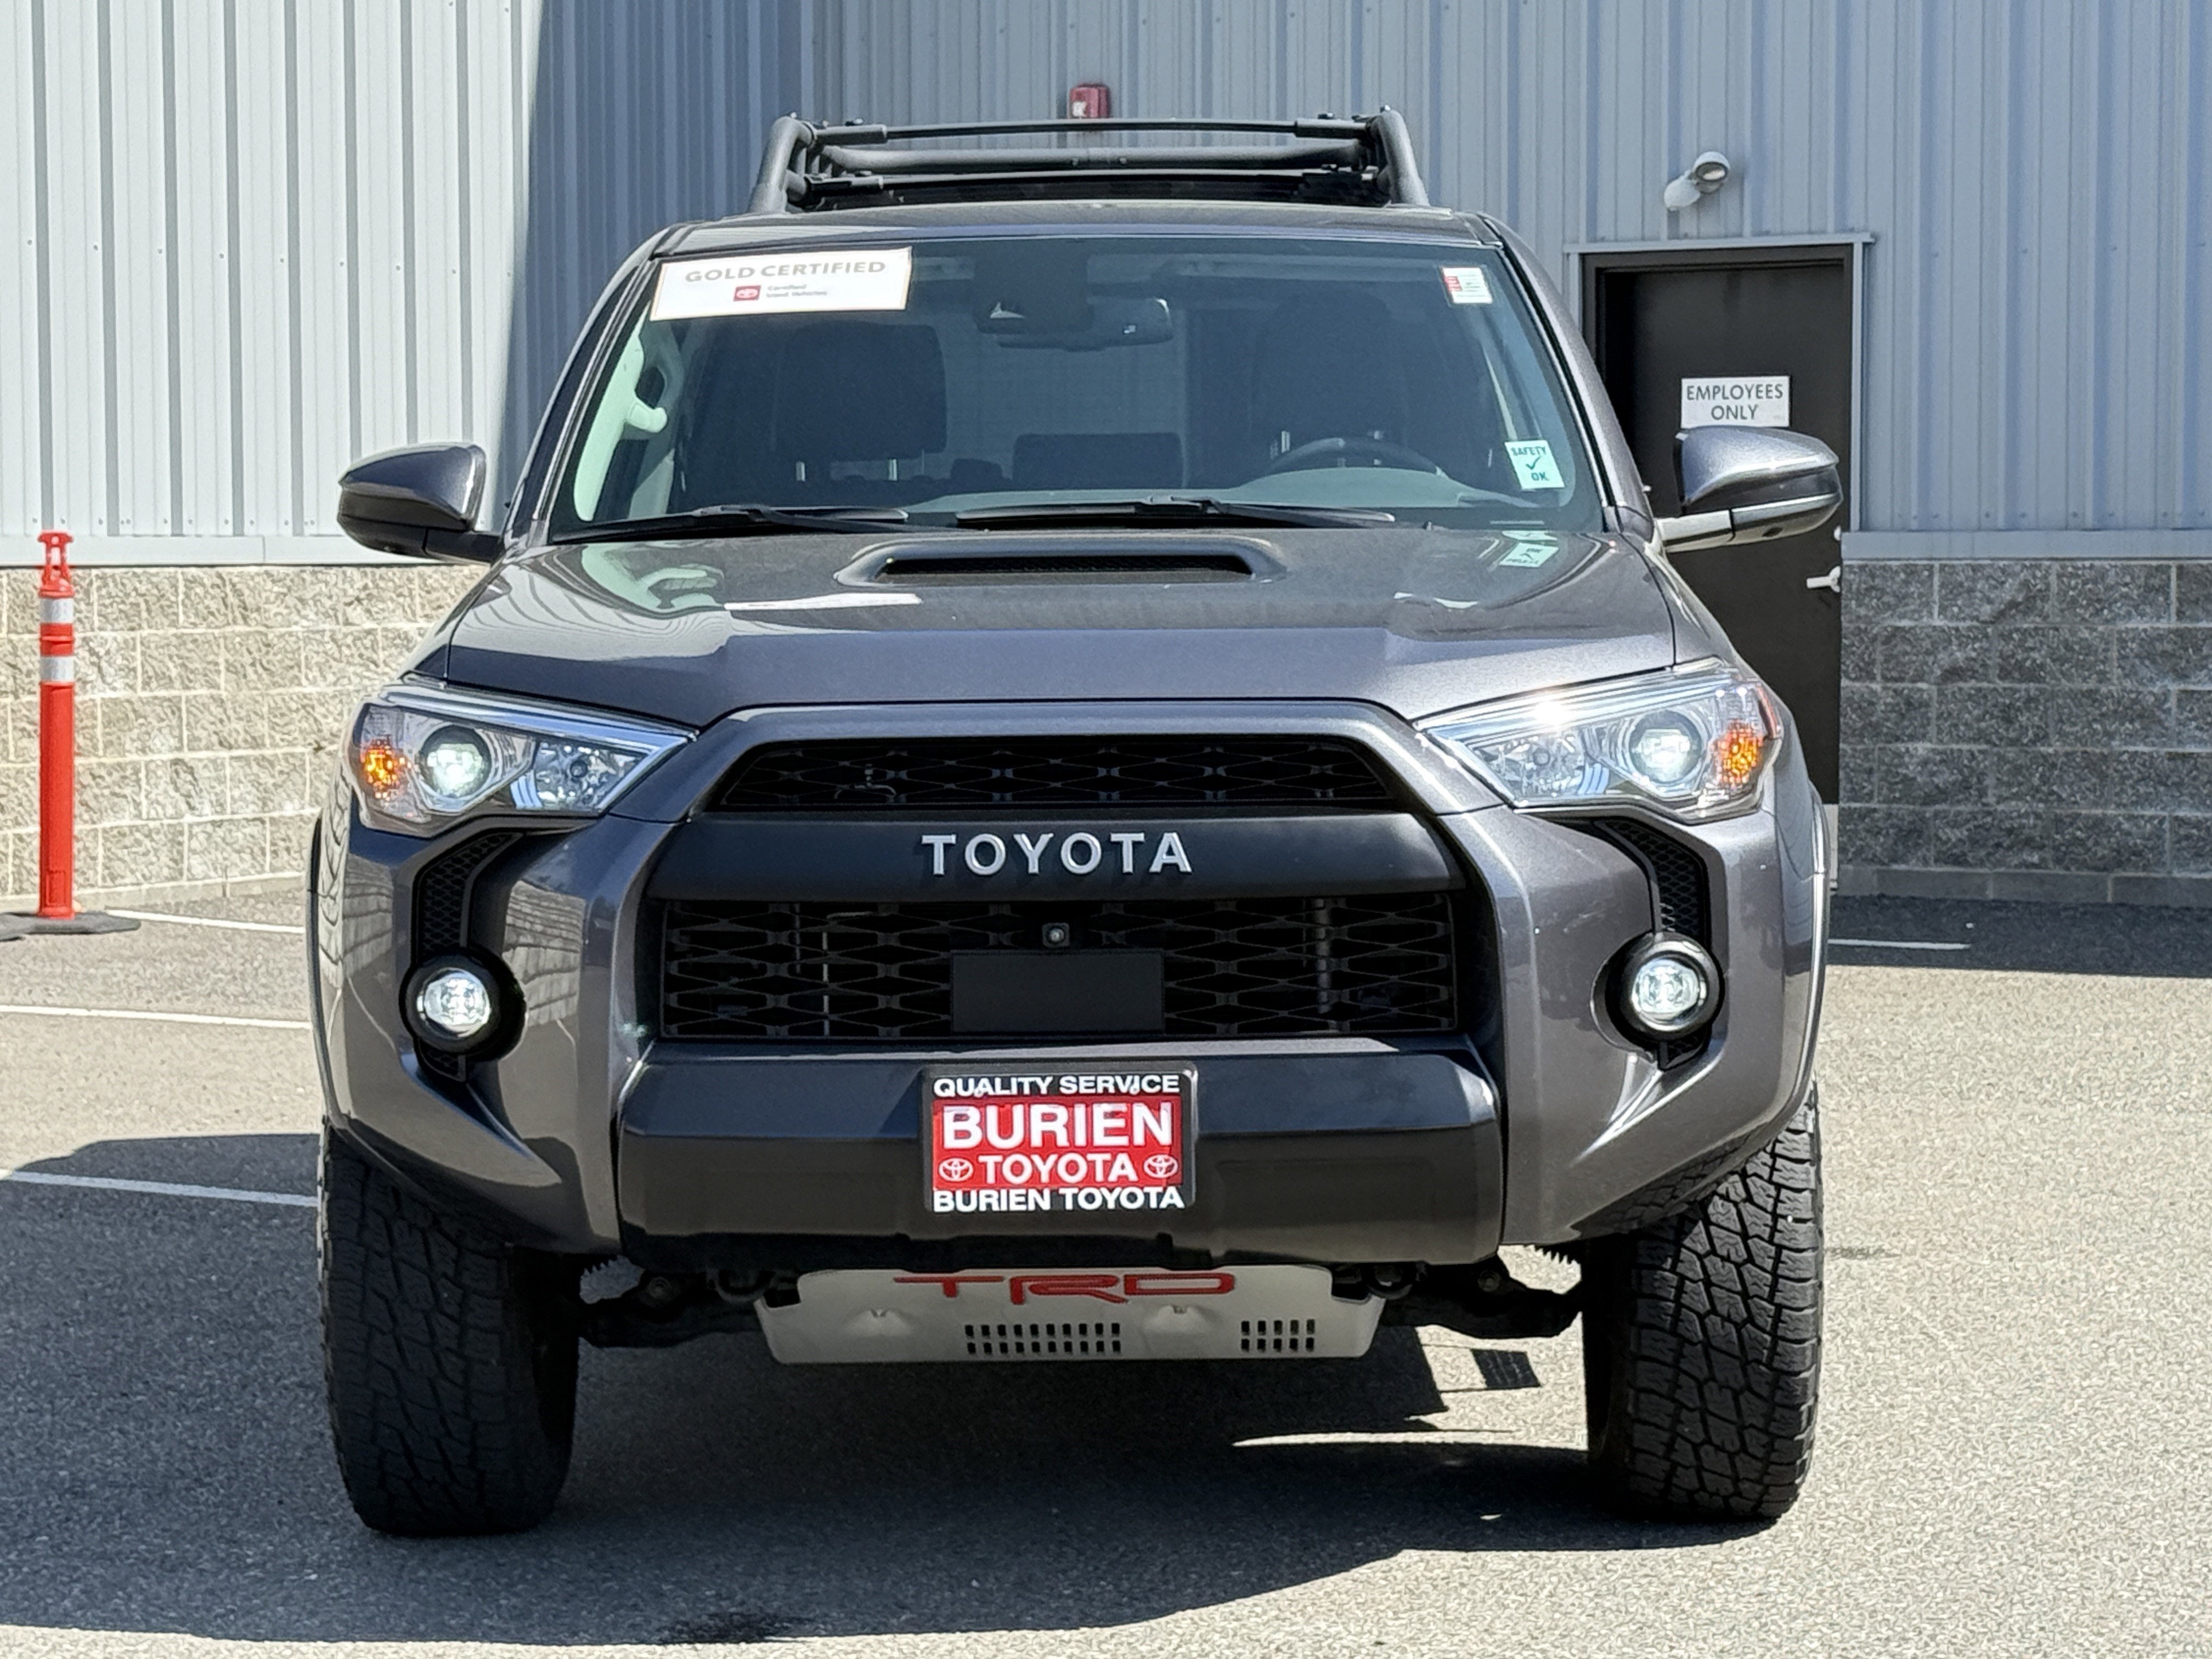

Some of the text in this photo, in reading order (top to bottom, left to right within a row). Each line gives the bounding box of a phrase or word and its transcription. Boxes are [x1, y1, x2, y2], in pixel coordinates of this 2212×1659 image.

[685, 262, 886, 282] GOLD CERTIFIED
[1686, 383, 1783, 400] EMPLOYEES
[1711, 404, 1758, 421] ONLY
[1510, 446, 1546, 456] SAFETY
[1531, 471, 1549, 481] OK
[921, 832, 1192, 876] TOYOTA
[933, 1075, 1181, 1097] QUALITY SERVICE
[943, 1102, 1173, 1149] BURIEN
[978, 1153, 1138, 1184] TOYOTA
[933, 1187, 1186, 1212] BURIEN TOYOTA
[893, 1273, 1236, 1305] TRD
